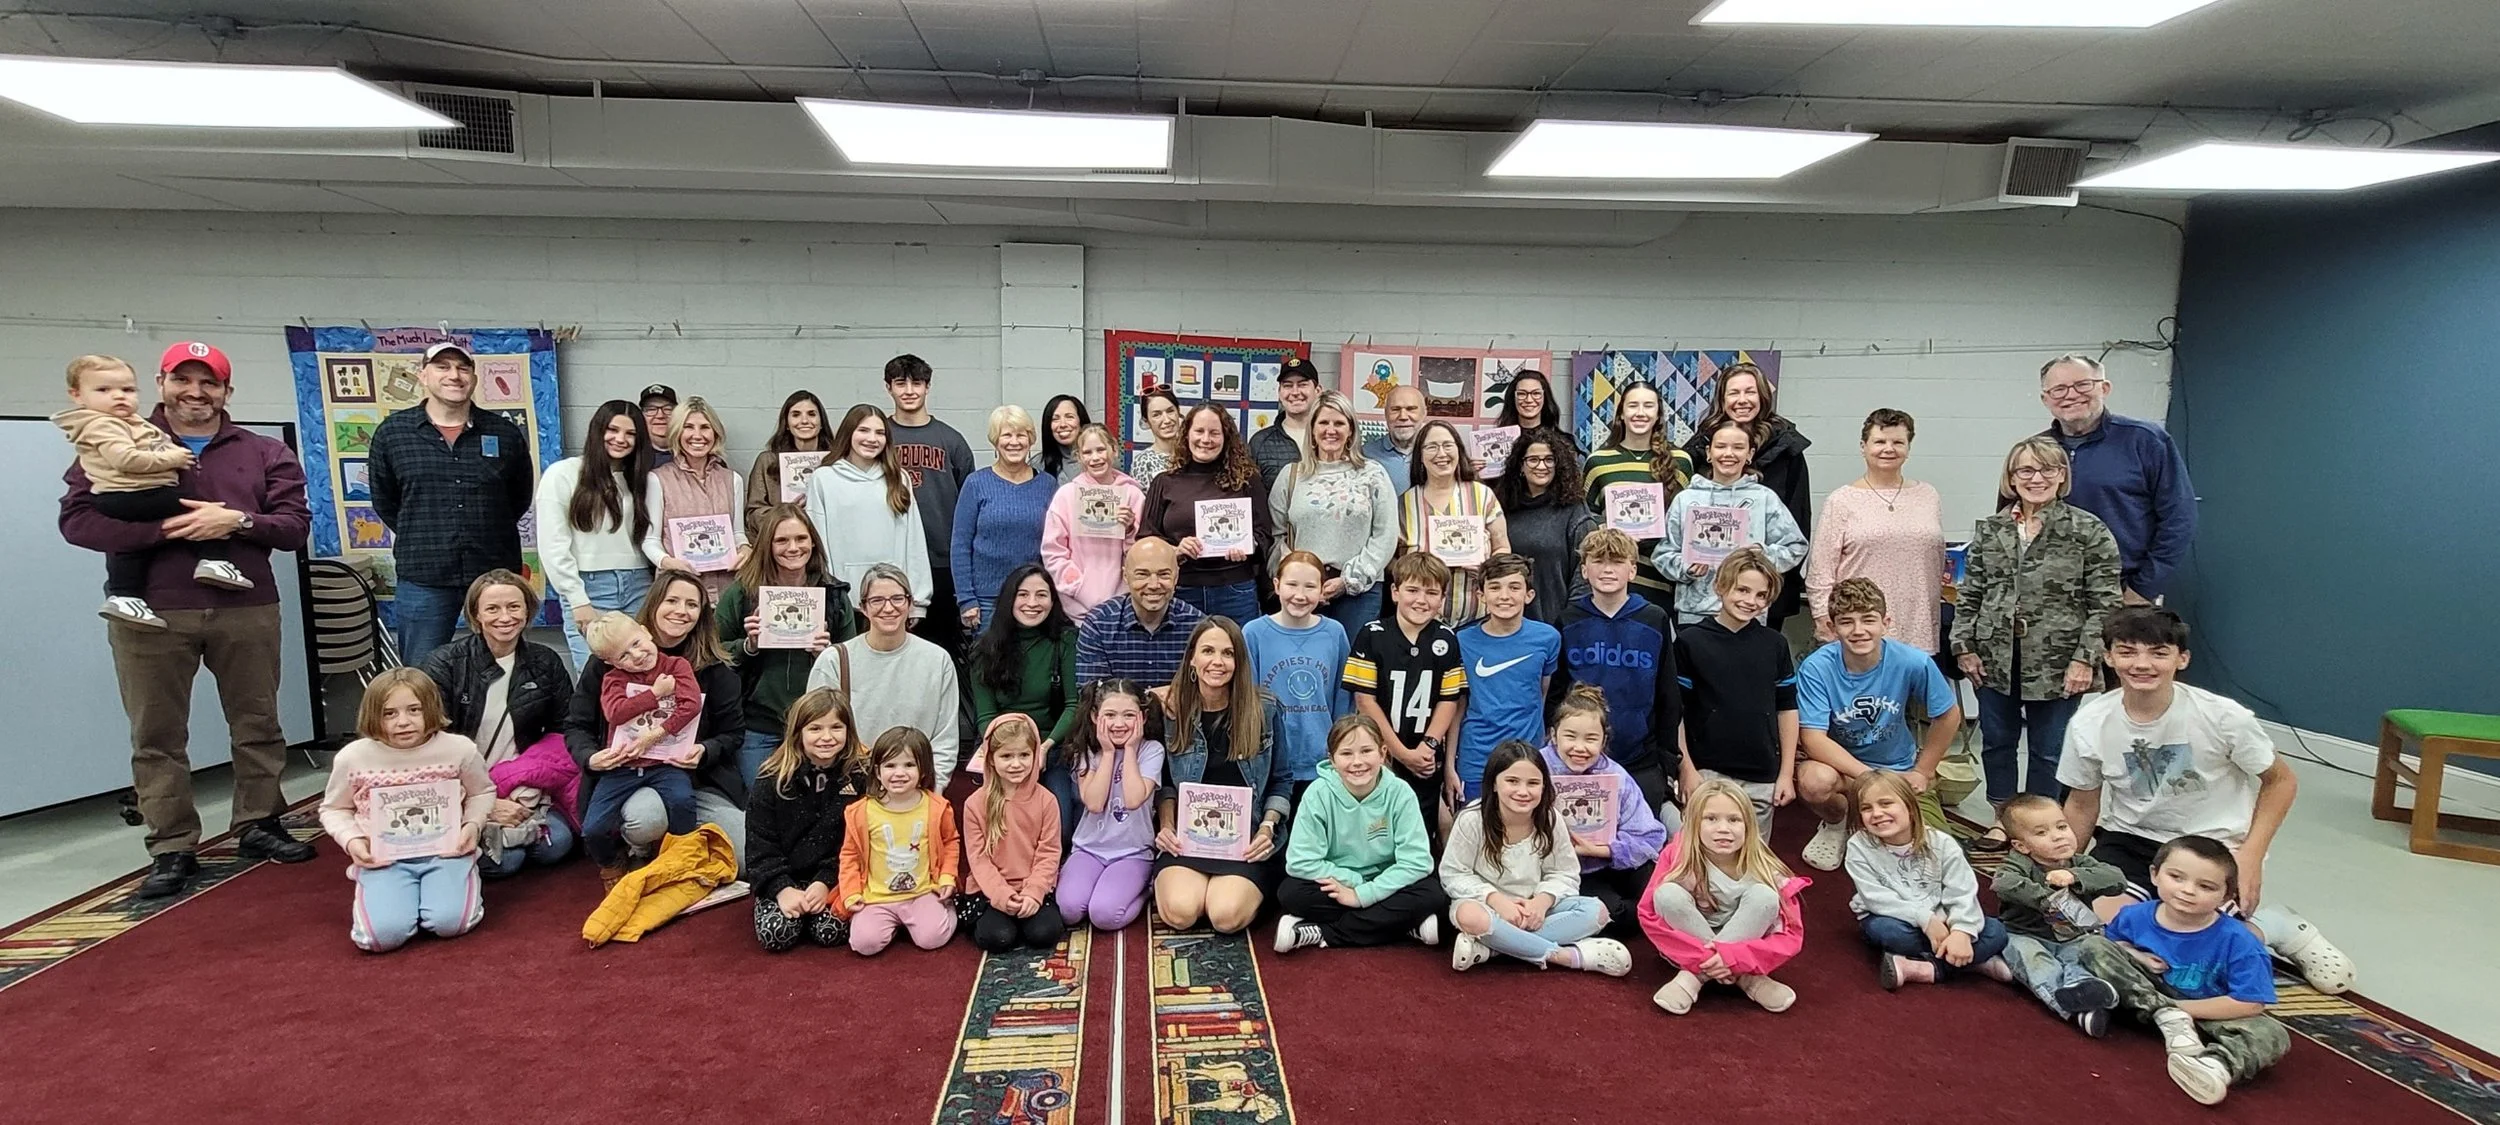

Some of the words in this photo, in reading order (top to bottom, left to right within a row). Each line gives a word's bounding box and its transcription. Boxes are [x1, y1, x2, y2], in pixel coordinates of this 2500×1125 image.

[377, 335, 396, 347] The
[396, 331, 422, 345] Much
[894, 443, 946, 472] BURN
[1567, 641, 1653, 669] adidas
[1263, 656, 1312, 688] HAPPIEST
[1285, 704, 1310, 713] RICAN
[1311, 704, 1328, 713] EAG
[1389, 669, 1433, 734] 14
